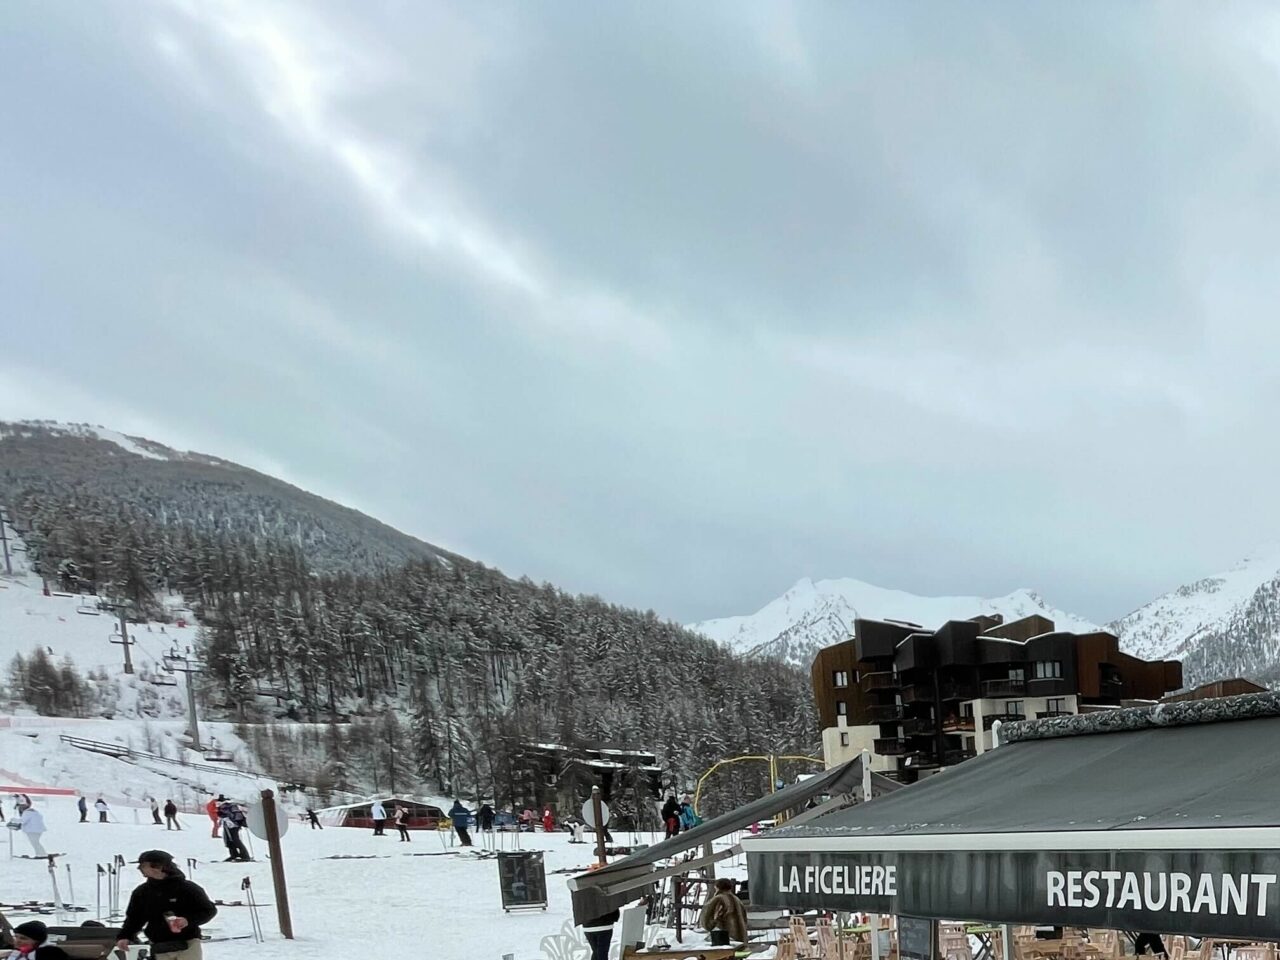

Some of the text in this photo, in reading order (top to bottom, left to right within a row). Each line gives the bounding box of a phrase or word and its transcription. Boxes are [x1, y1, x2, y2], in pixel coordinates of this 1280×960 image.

[779, 865, 897, 896] LA FICELIERE
[1047, 871, 1277, 916] RESTAURANT
